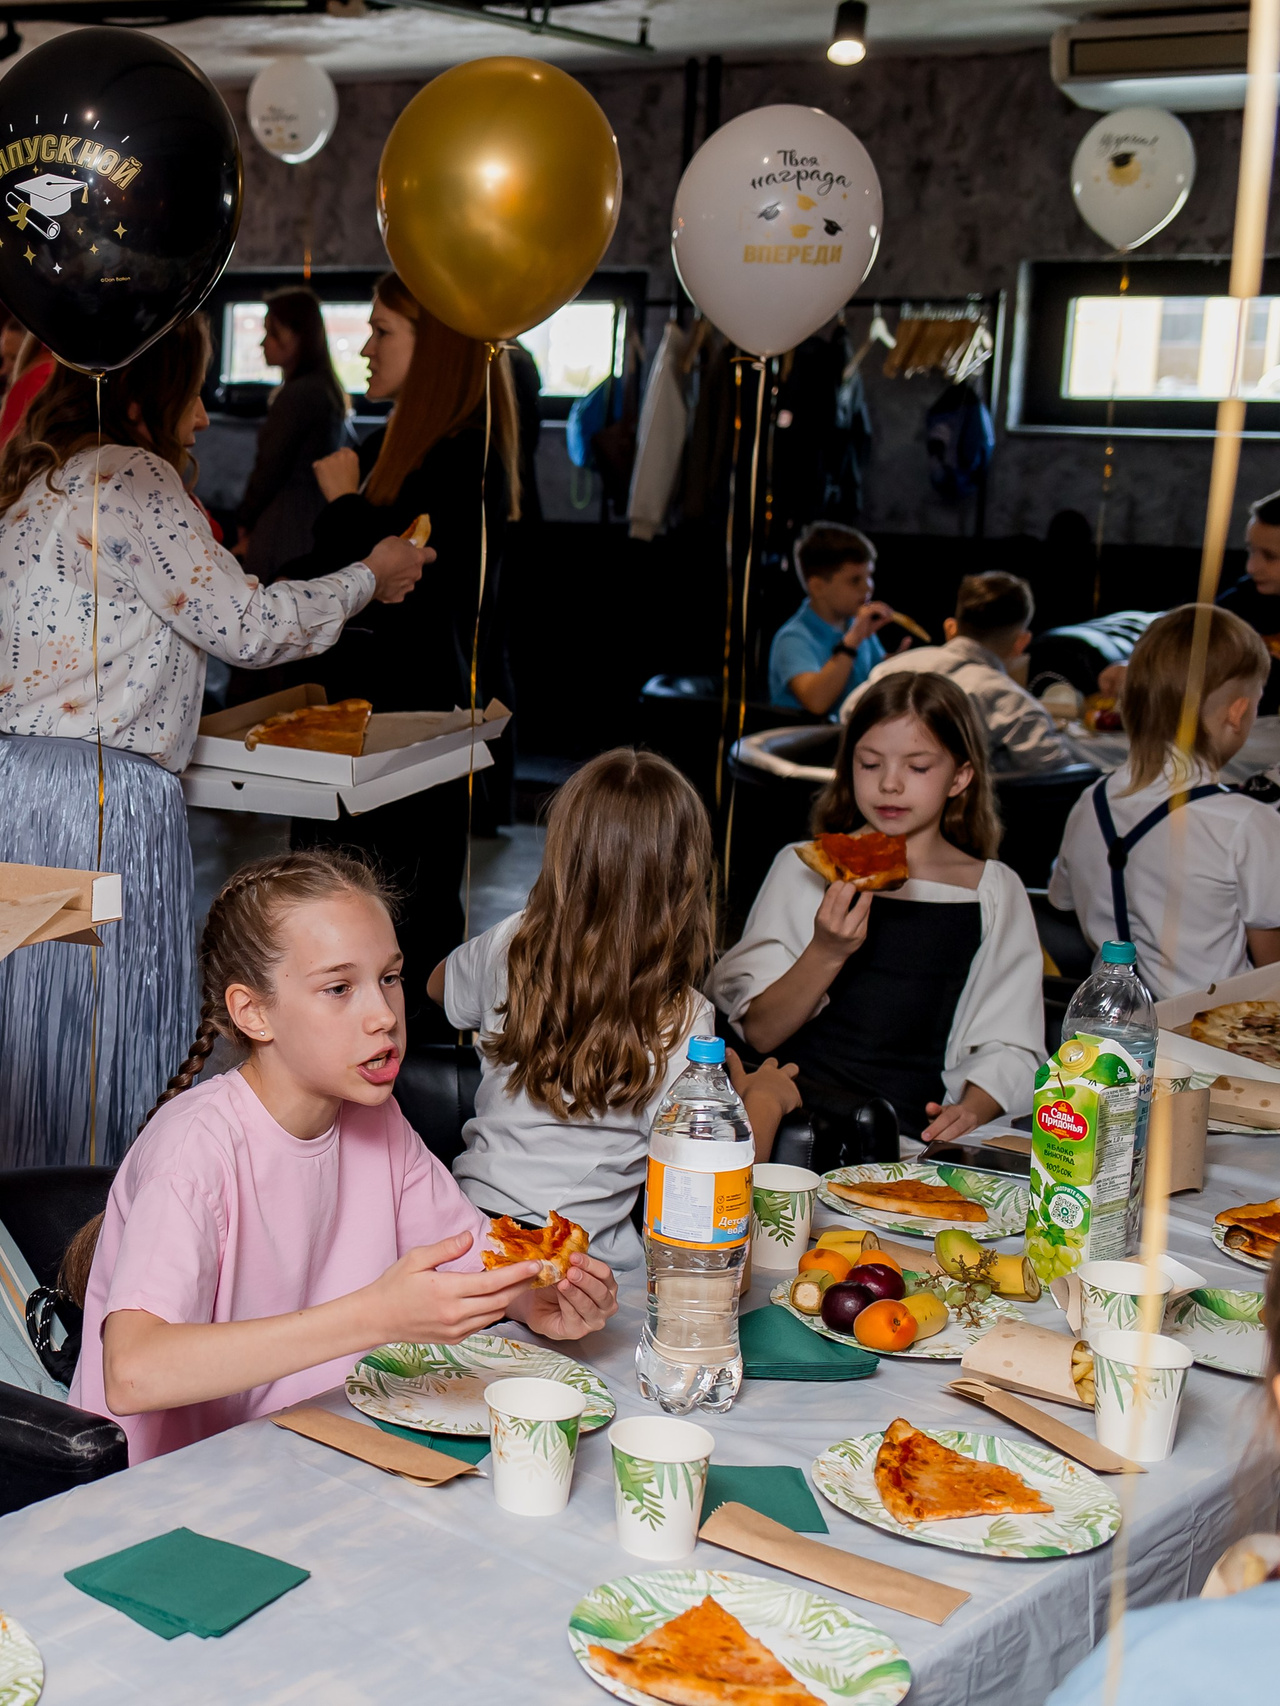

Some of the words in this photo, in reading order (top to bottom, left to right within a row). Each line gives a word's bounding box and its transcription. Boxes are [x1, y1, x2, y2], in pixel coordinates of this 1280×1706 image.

[777, 149, 819, 167] Твоя
[751, 169, 852, 196] награда
[742, 244, 843, 266] ВПЕРЕДИ
[1041, 1112, 1084, 1134] Придонья
[1050, 1107, 1075, 1124] Сады
[1043, 1149, 1075, 1166] ВИНОГРАД
[1046, 1142, 1074, 1157] ЯБЛОКО
[1046, 1162, 1061, 1174] 100%
[1060, 1167, 1073, 1178] СОК
